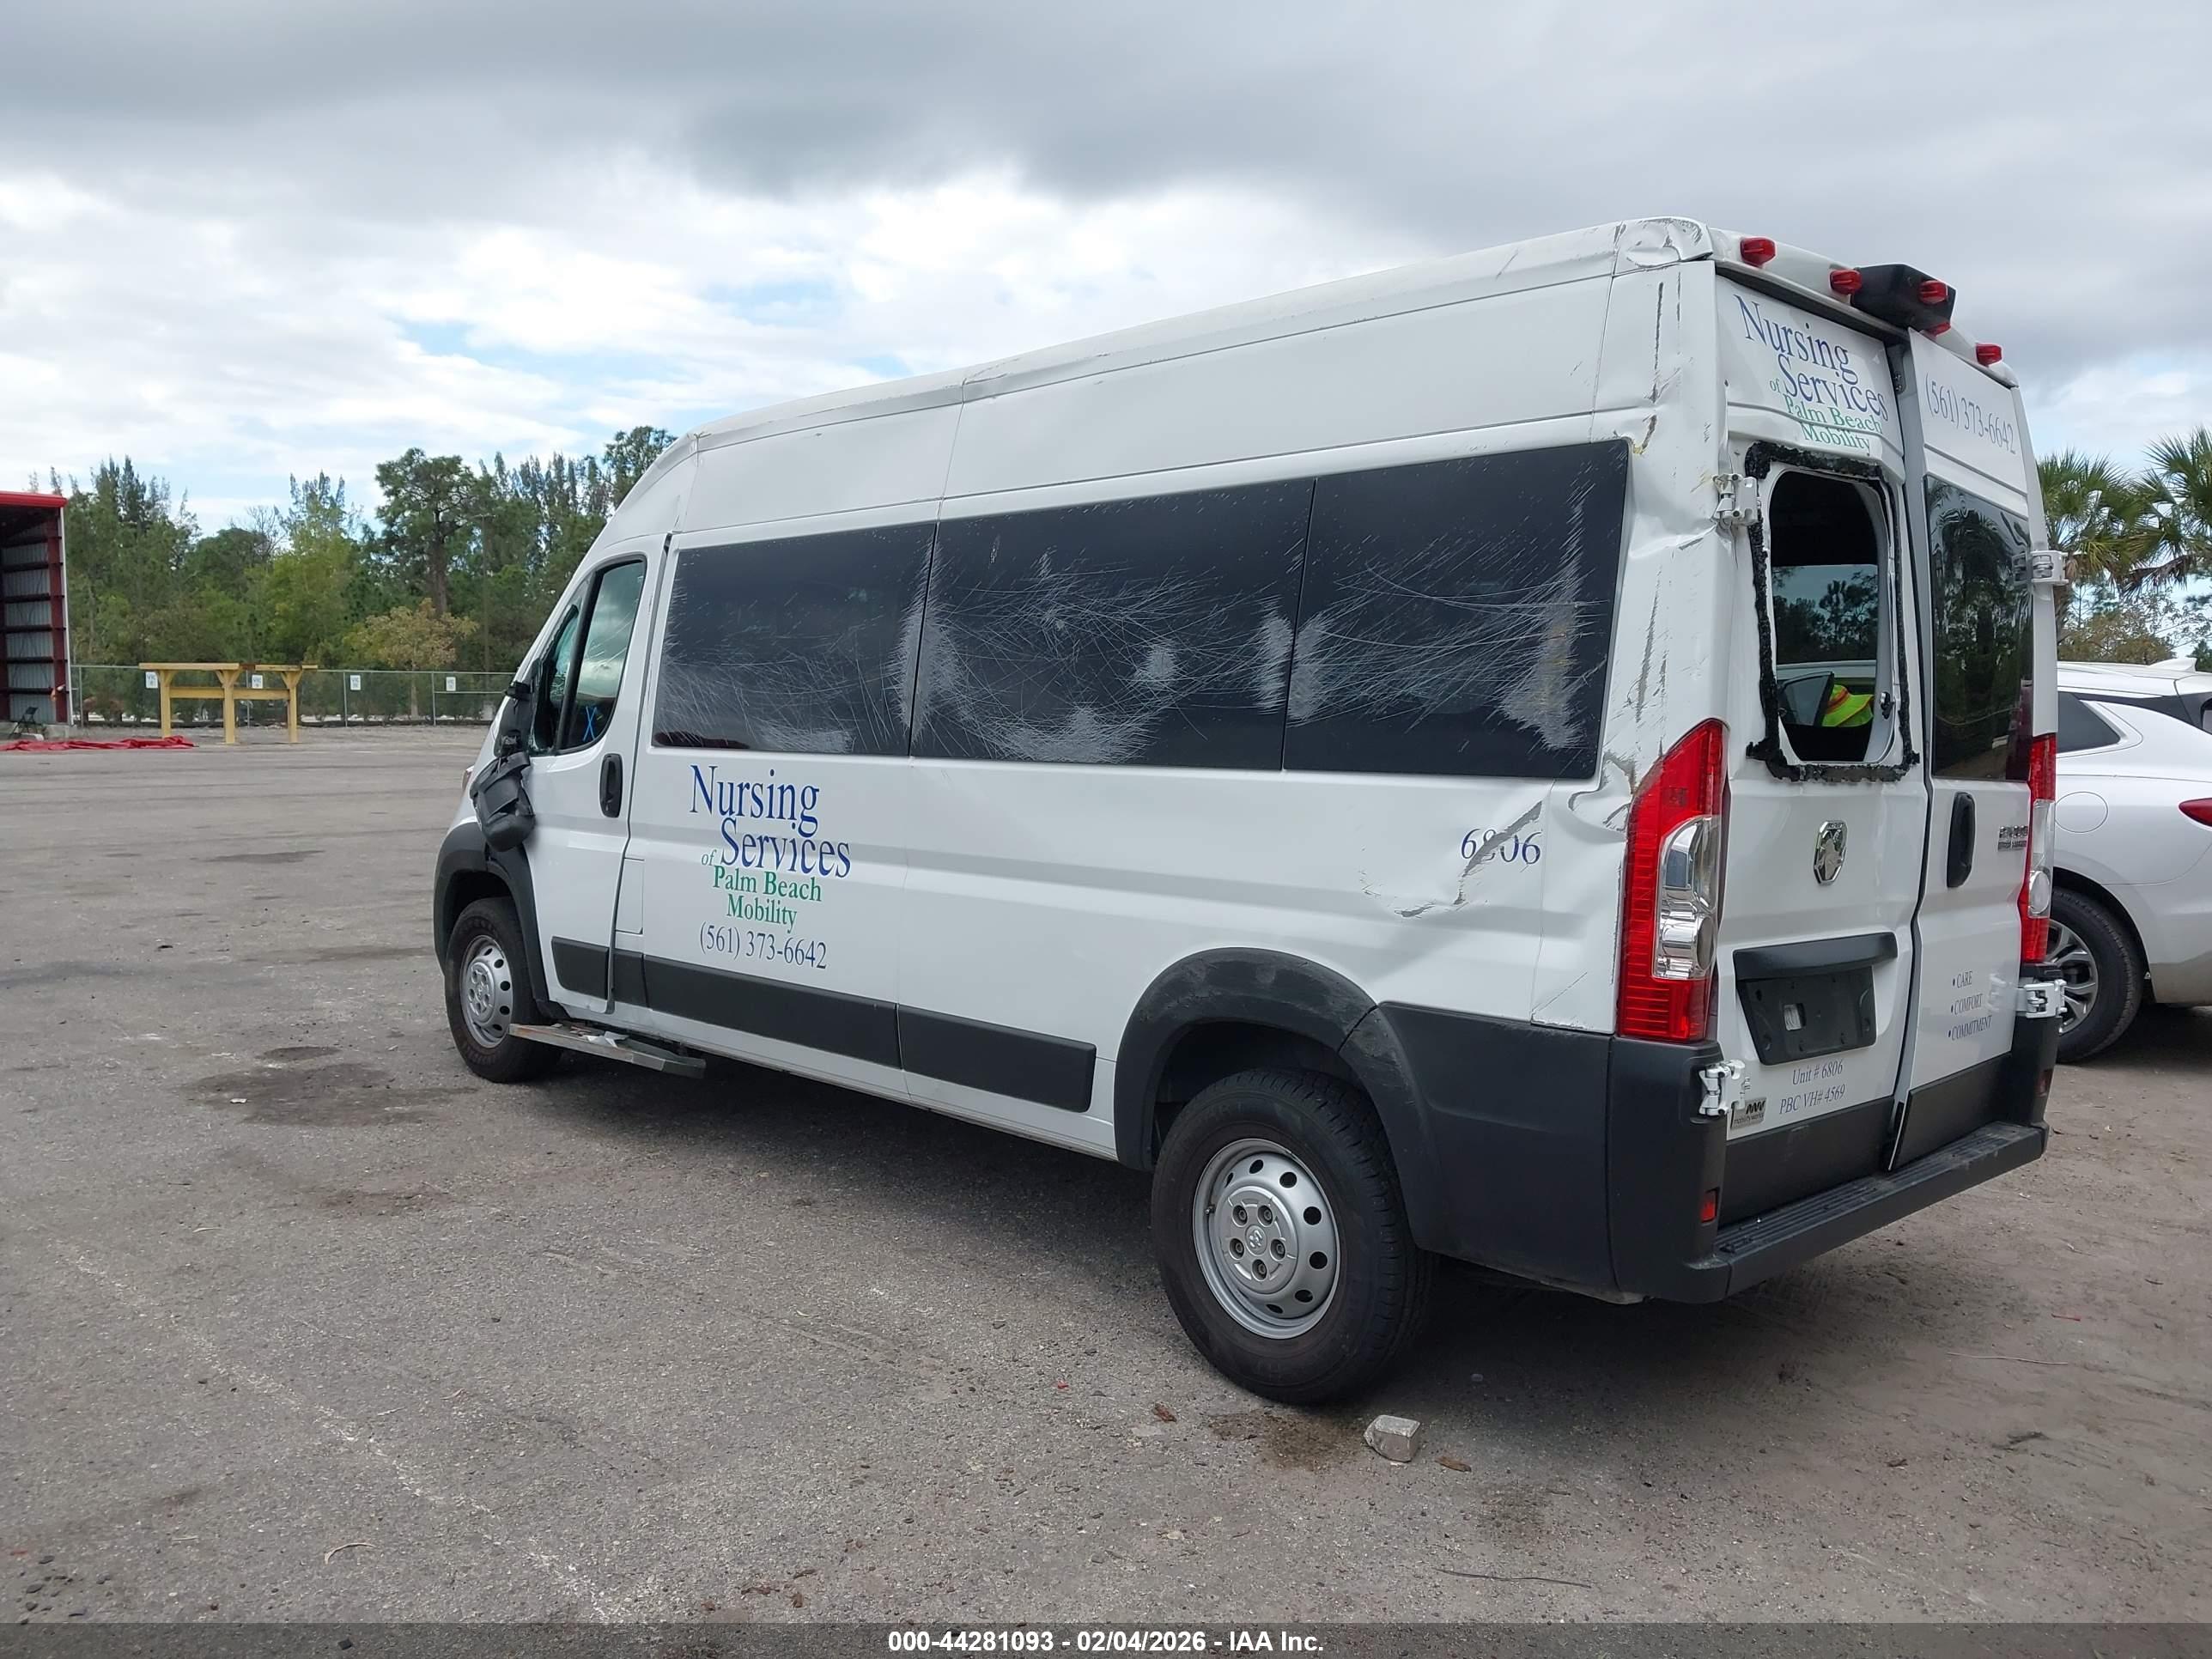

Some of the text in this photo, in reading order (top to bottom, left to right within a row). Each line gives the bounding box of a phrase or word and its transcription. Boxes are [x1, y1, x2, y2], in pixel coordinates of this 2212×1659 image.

[1735, 295, 1859, 386] Nursing
[1769, 353, 1888, 422] of Services
[1783, 393, 1883, 434] Palm Beach
[1925, 372, 2016, 454] (561) 373-6642
[1801, 422, 1871, 457] Mobility
[690, 764, 820, 838] Nursing
[701, 817, 852, 878] of Services
[713, 865, 822, 902] Palm Beach
[726, 894, 797, 933] Mobility
[700, 921, 827, 969] (561) 373-6642
[1956, 970, 1973, 988] CARE
[1954, 993, 1984, 1015] COMFORT
[1792, 1059, 1844, 1085] Unit # 6806
[1779, 1094, 1802, 1115] PBC
[1803, 1090, 1823, 1109] VH#
[1824, 1084, 1846, 1103] 4569
